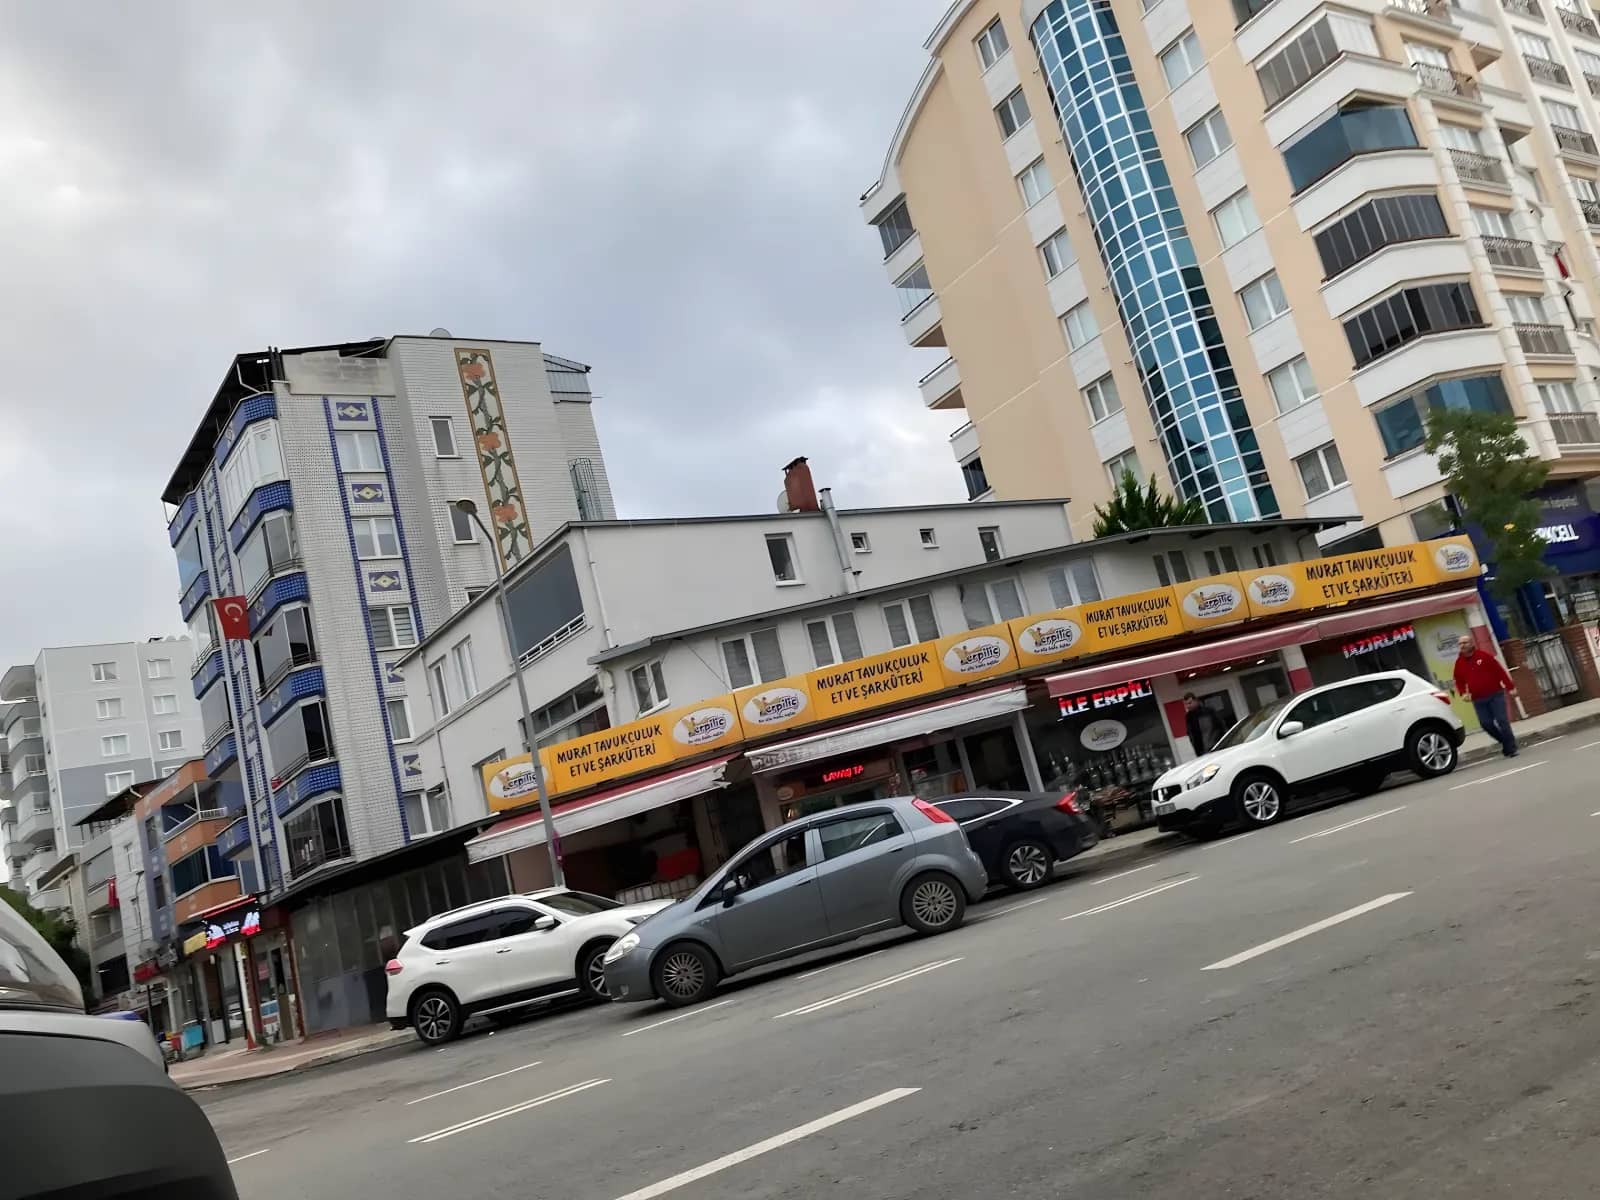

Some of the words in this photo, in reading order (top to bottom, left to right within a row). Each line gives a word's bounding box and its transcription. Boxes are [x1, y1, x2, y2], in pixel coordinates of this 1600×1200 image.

[1306, 562, 1345, 580] MURAT
[1346, 550, 1417, 574] TAVUKÇULUK
[1323, 585, 1338, 599] ET
[1338, 582, 1353, 595] VE
[1353, 569, 1413, 596] ŞARKÜTERİ
[1086, 606, 1116, 624] MURAT
[1116, 596, 1172, 618] TAVUKÇULUK
[1097, 626, 1107, 639] ET
[1108, 624, 1121, 636] VE
[1120, 614, 1169, 636] ŞARKÜTERİ
[816, 670, 856, 690] MURAT
[856, 651, 930, 679] TAVUKÇULUK
[831, 691, 843, 705] ET
[843, 688, 861, 701] VE
[860, 668, 924, 700] ŞARKÜTERİ
[557, 742, 592, 765] MURAT
[593, 725, 663, 754] TAVUKÇULUK
[570, 763, 582, 778] ET
[582, 760, 598, 774] VE
[597, 740, 656, 772] ŞARKÜTERİ
